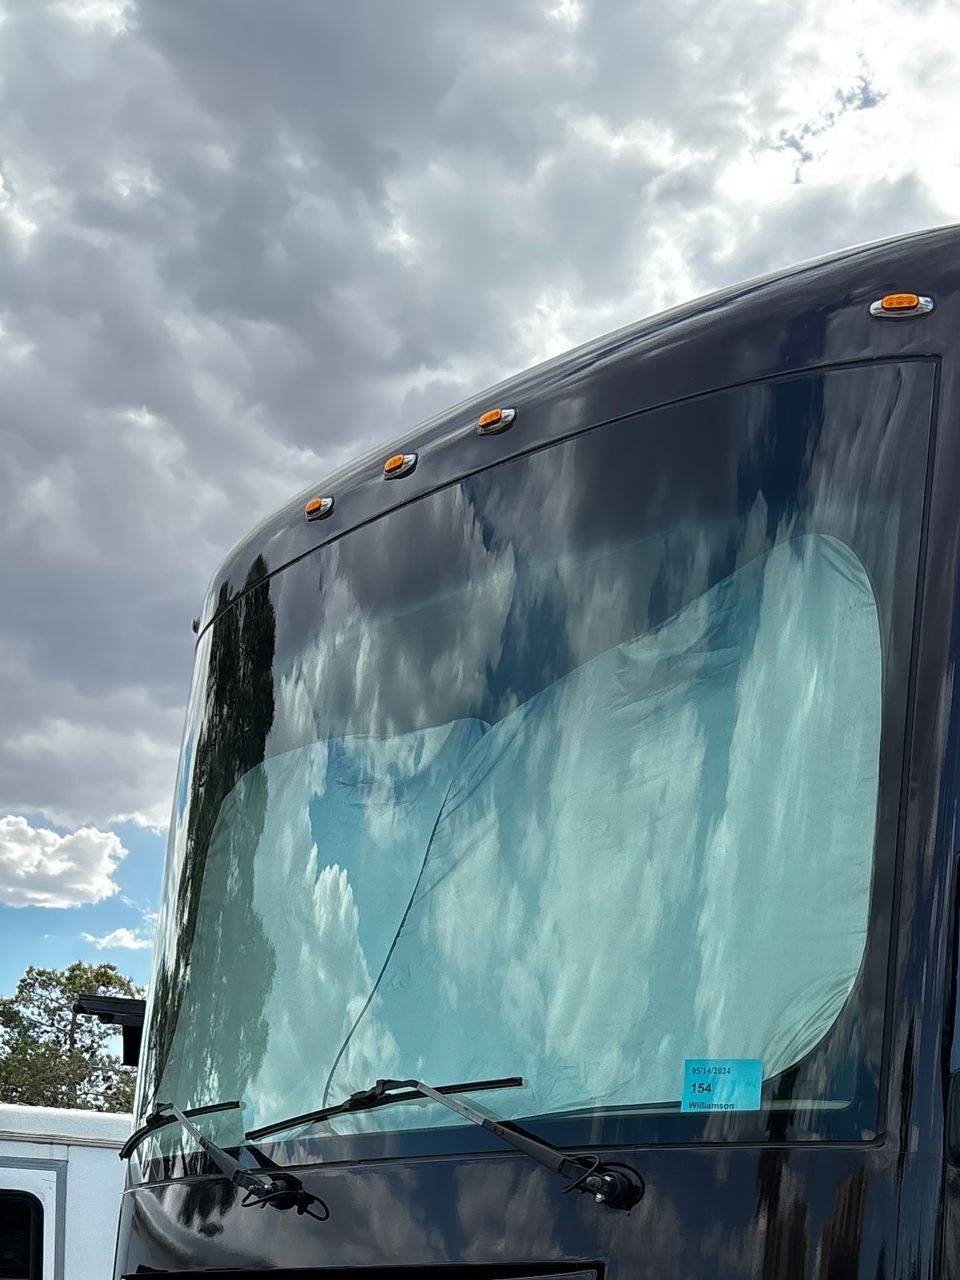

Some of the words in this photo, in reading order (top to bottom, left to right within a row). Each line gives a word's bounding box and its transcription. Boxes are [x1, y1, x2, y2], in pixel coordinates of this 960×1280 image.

[691, 1067, 731, 1075] 05/14/2024
[691, 1082, 712, 1094] 154
[688, 1101, 735, 1110] Williamson
